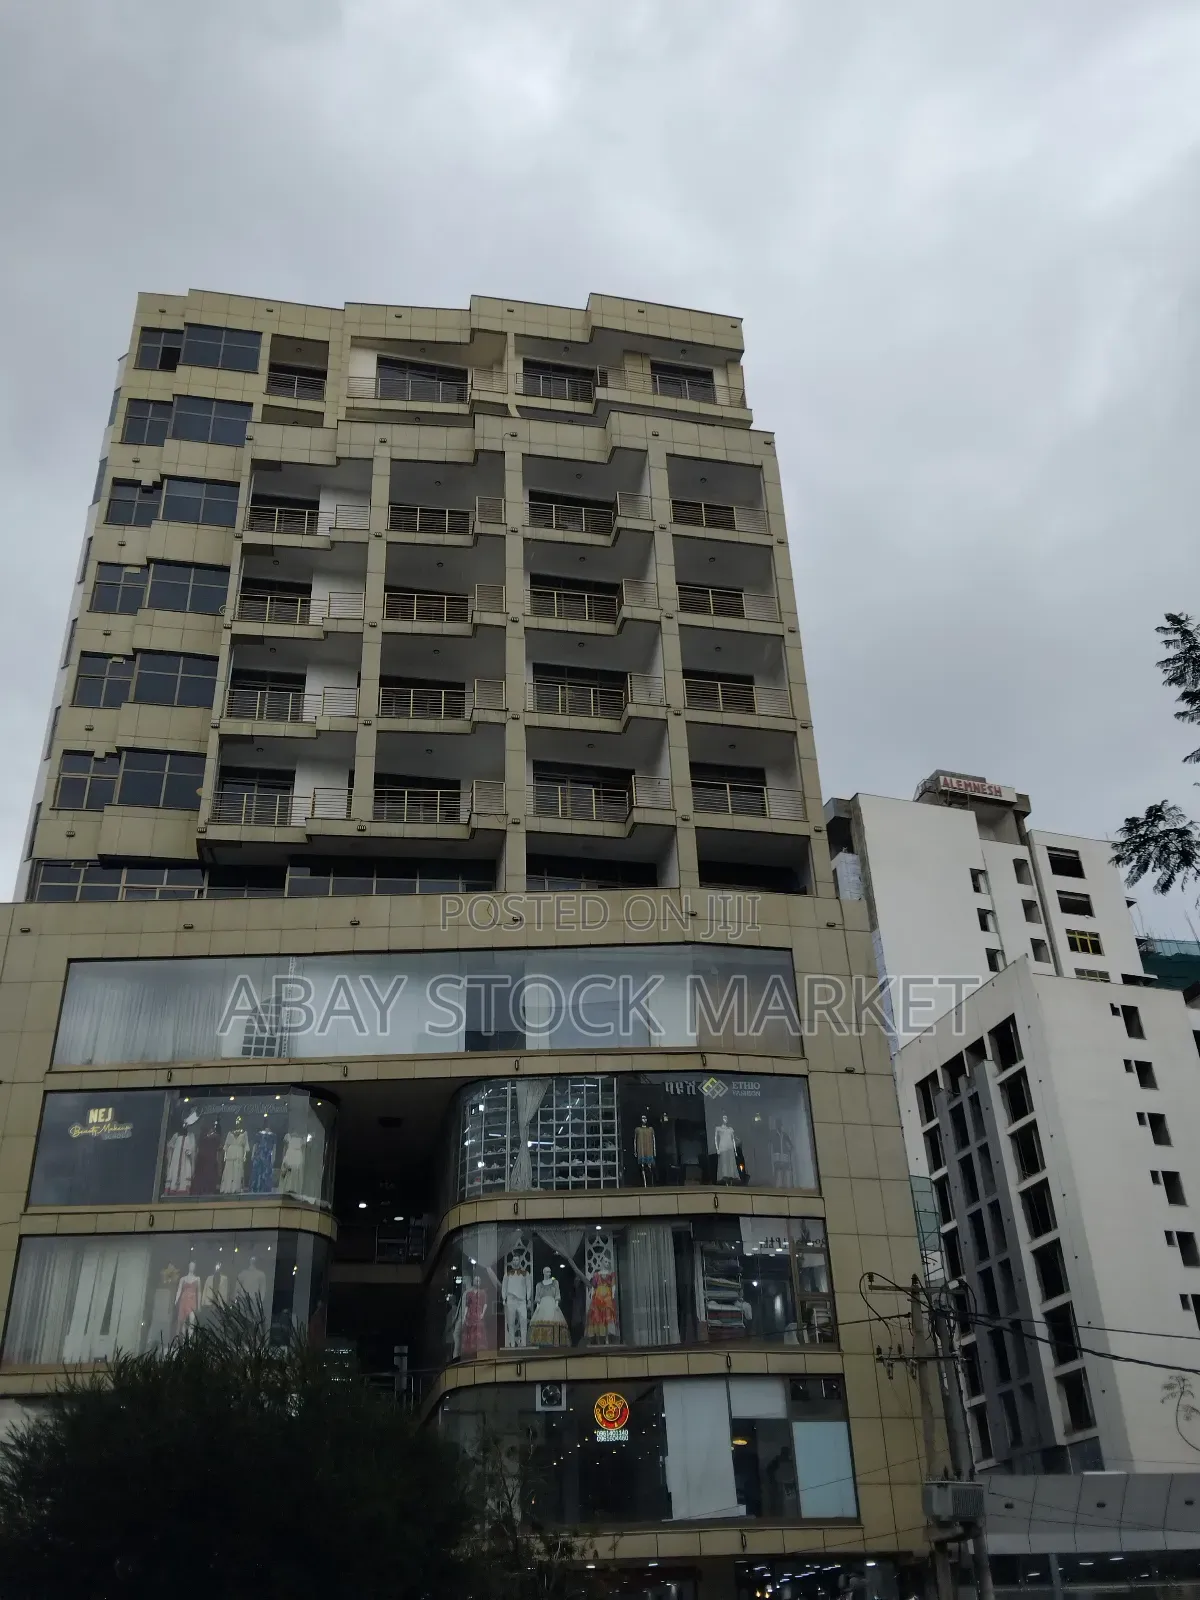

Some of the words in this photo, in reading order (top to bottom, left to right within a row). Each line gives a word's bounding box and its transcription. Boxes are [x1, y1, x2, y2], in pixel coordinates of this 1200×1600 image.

[942, 777, 1003, 797] ALEMNESH
[732, 1081, 761, 1090] ETHIO
[88, 1107, 113, 1124] NEJ
